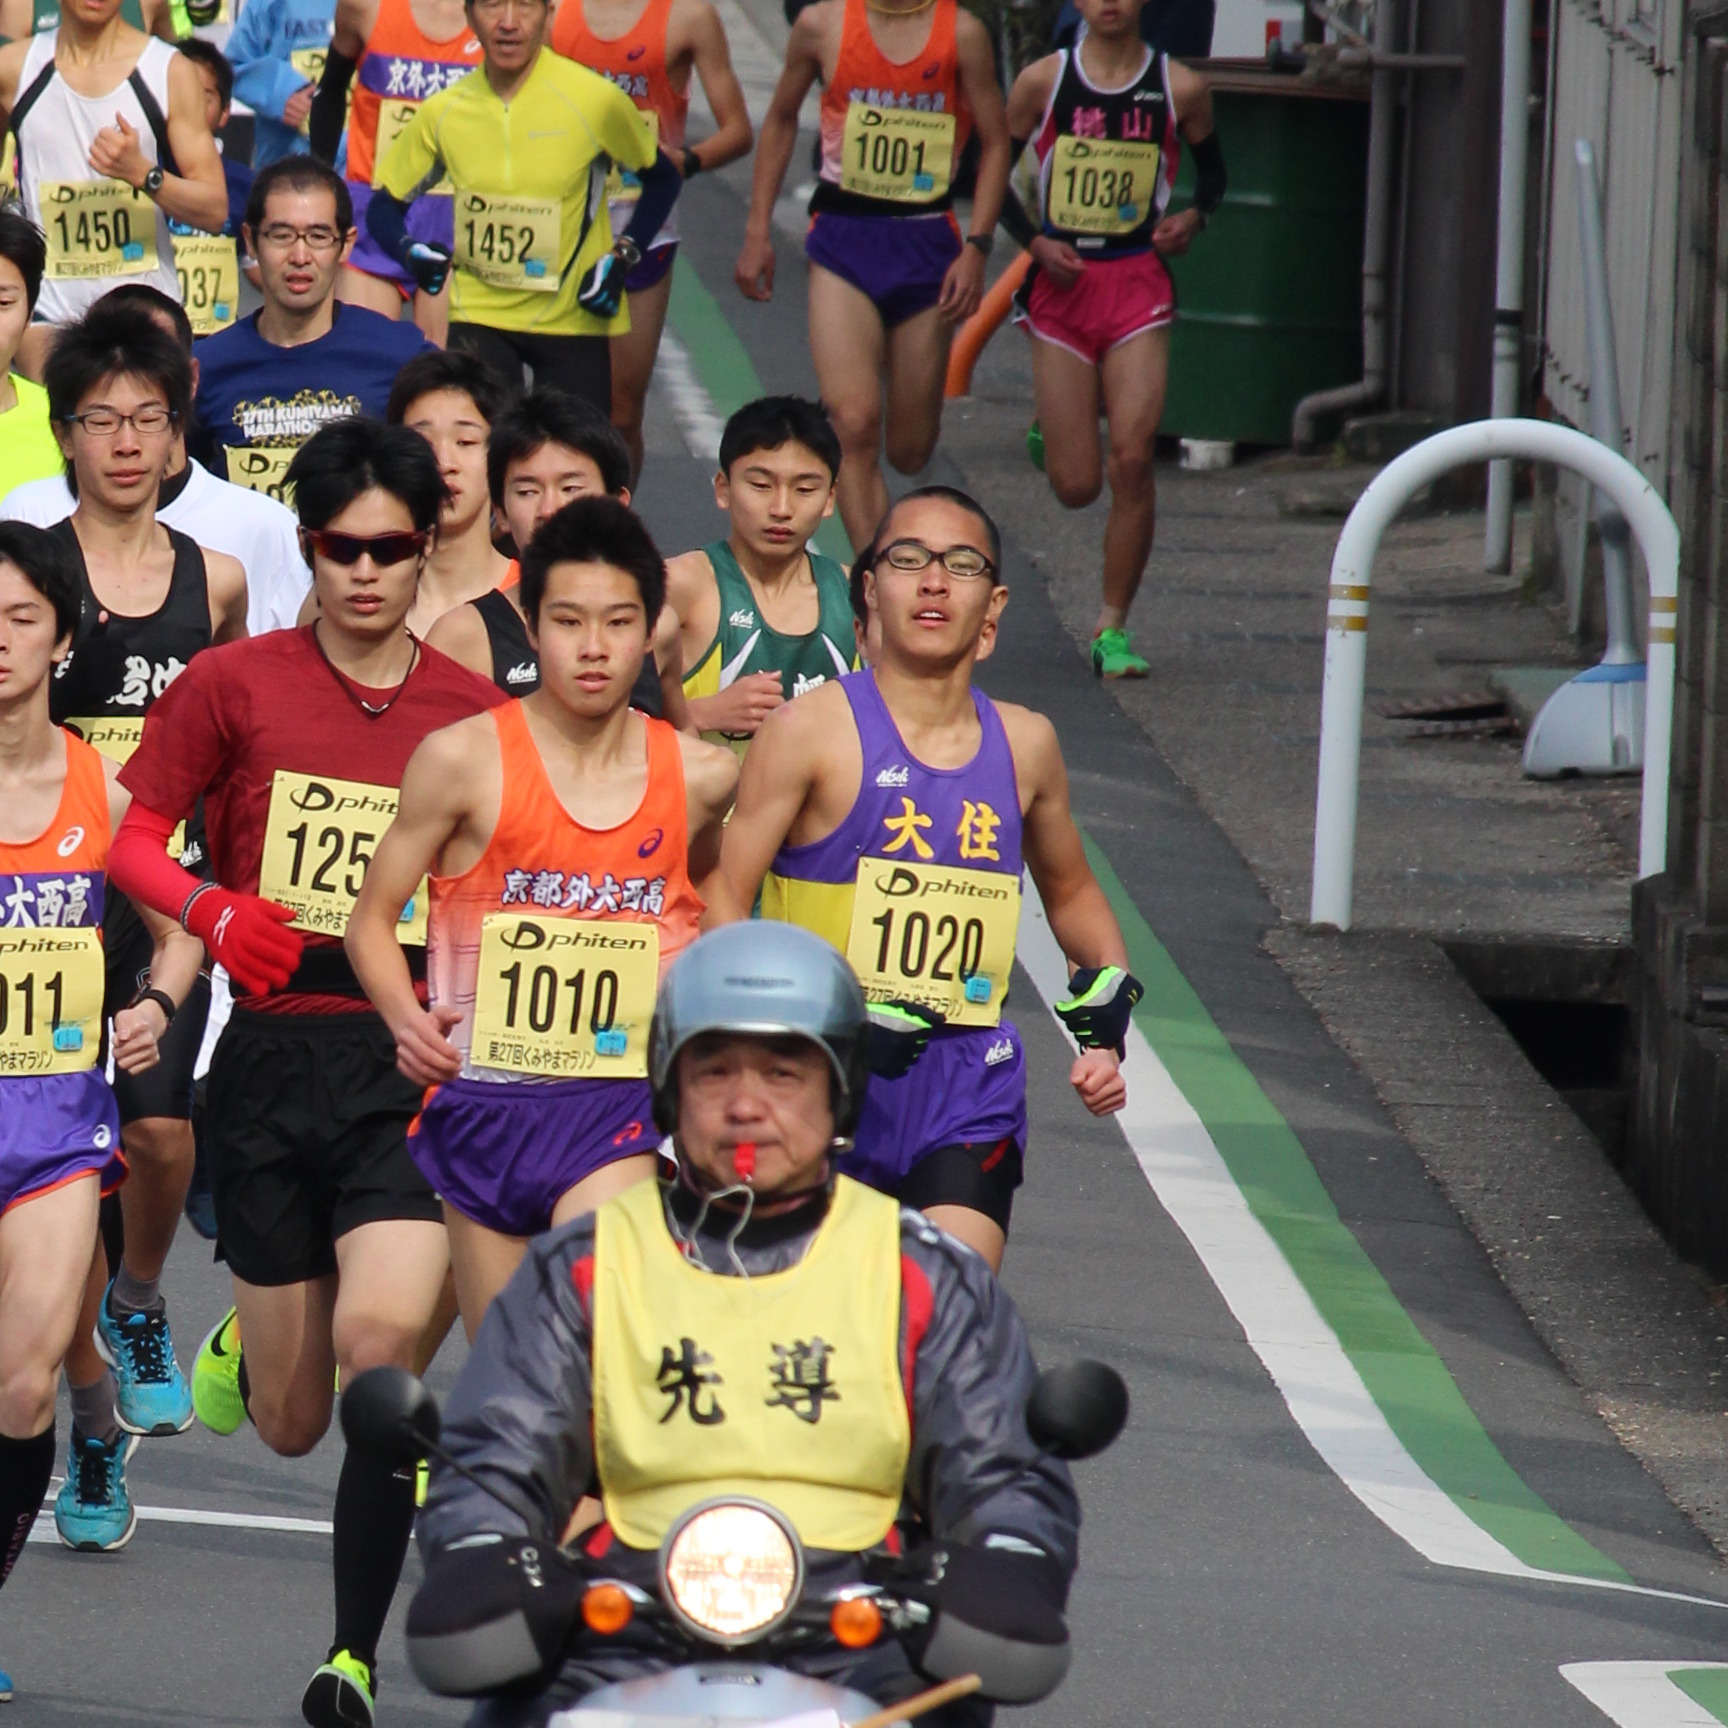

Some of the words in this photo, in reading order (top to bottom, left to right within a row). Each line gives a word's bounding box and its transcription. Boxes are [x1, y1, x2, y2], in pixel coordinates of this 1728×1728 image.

[855, 132, 926, 177] 1001
[1065, 164, 1135, 210] 1038
[54, 207, 132, 253] 1450
[465, 218, 535, 265] 1452
[176, 266, 222, 309] 037
[87, 727, 144, 746] phit
[334, 795, 400, 816] phit
[881, 795, 1003, 862] 大住
[286, 821, 377, 898] 125
[502, 868, 667, 916] 京都外大西高
[919, 877, 1010, 901] phiten
[546, 931, 648, 952] phiten
[872, 907, 985, 985] 1020
[499, 961, 620, 1036] 1010
[656, 1335, 843, 1427] 先導
